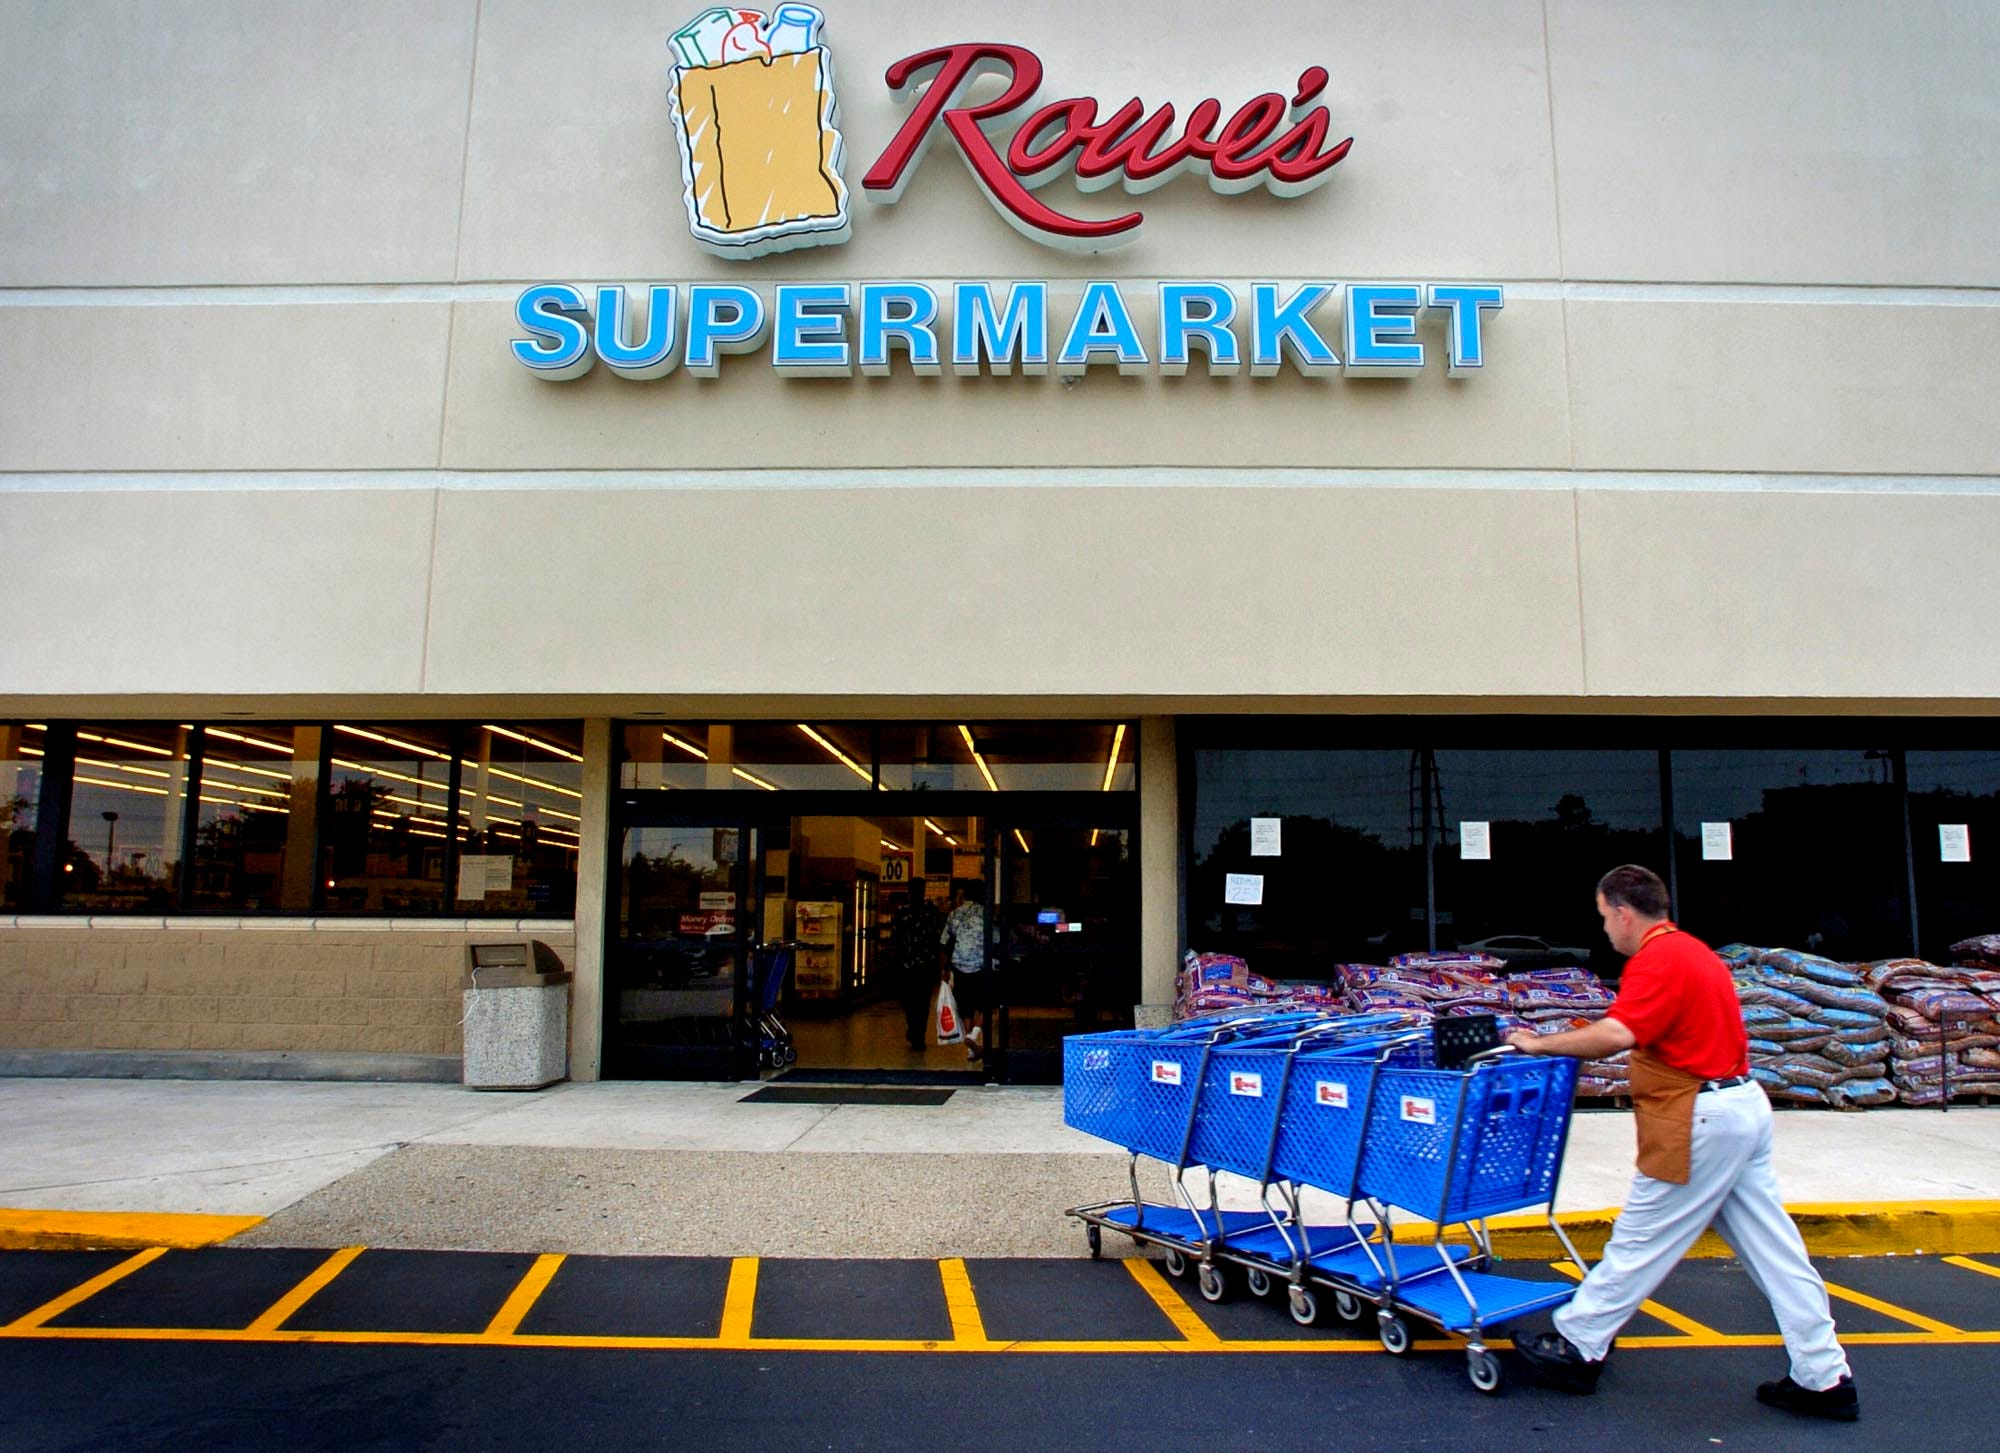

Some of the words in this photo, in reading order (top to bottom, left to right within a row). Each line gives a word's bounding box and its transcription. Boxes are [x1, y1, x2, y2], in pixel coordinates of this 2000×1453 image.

[861, 43, 1354, 237] Rowe's
[510, 283, 1504, 370] SUPERMARKET
[680, 915, 708, 925] Money
